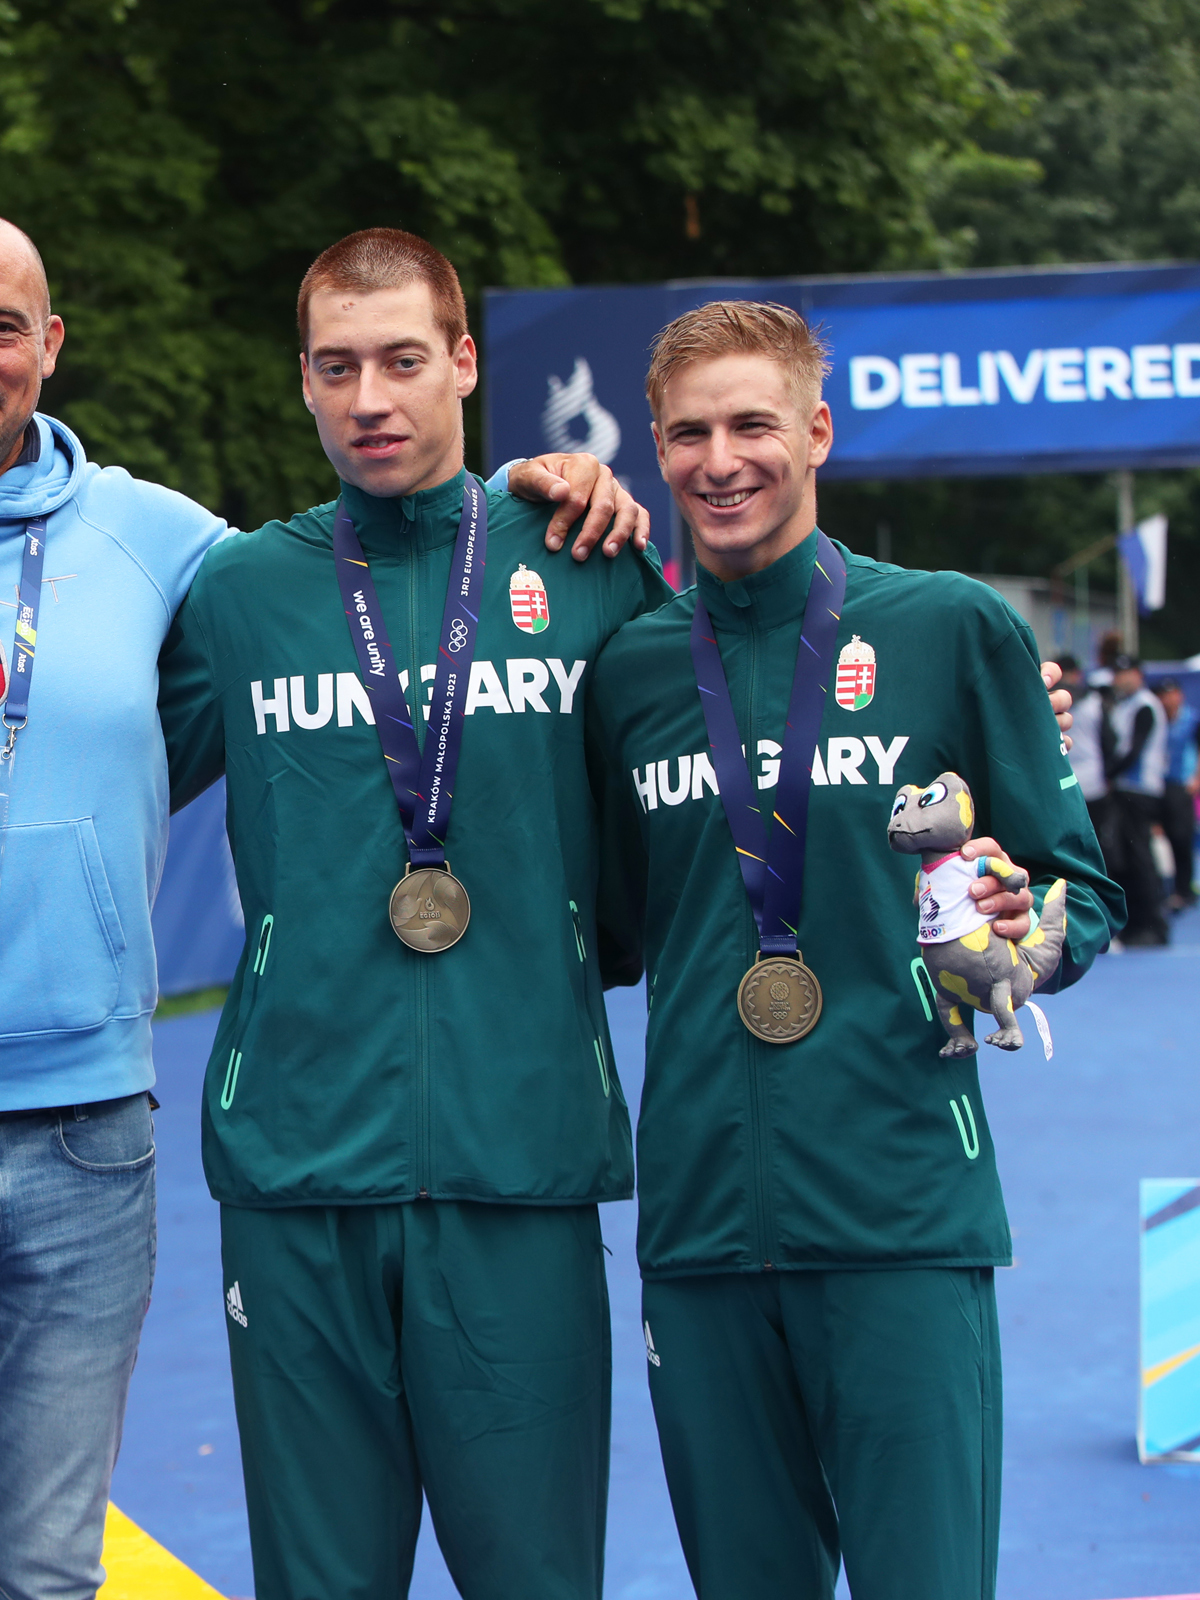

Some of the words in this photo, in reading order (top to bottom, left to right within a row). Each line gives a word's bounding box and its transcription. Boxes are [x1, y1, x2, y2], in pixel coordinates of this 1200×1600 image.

[849, 343, 1200, 410] DELIVERED
[464, 521, 477, 574] EUROPEAN
[353, 590, 367, 613] we
[460, 576, 470, 597] 3RD
[359, 615, 375, 640] are
[366, 642, 386, 677] unity
[427, 776, 441, 823] KRAKÓW
[435, 700, 453, 772] MAŁOPOLSKA
[446, 673, 457, 697] 2023
